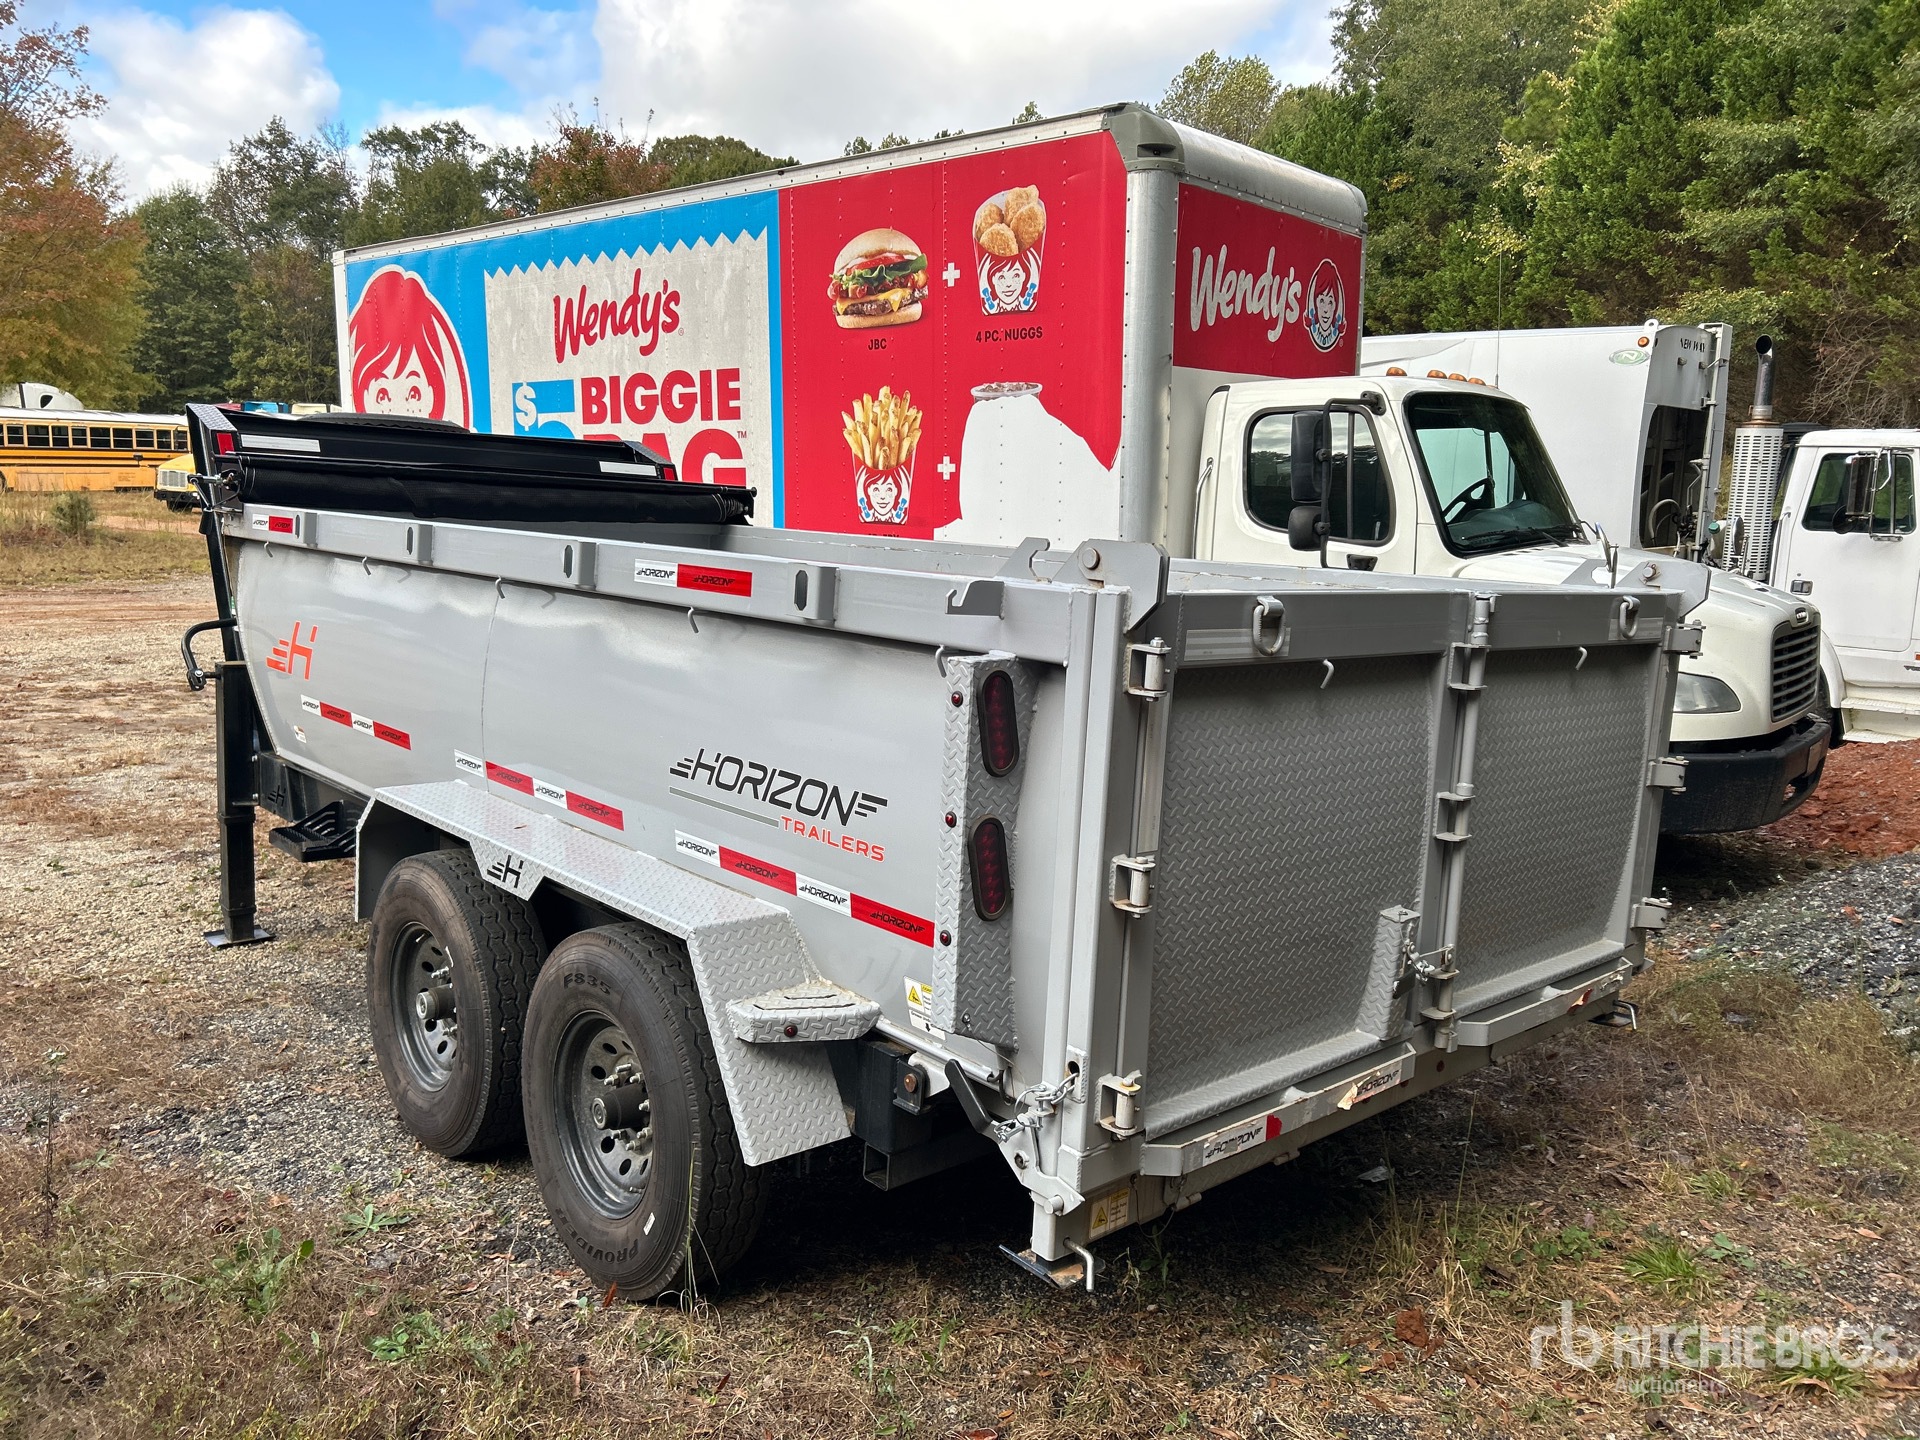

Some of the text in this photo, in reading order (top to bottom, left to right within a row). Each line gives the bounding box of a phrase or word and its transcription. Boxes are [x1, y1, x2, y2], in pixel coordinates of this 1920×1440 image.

[1191, 244, 1302, 342] Wendy's
[553, 267, 681, 364] Wendy's
[868, 338, 887, 350] JBC
[975, 326, 1043, 343] 4 PC. NUGGS
[581, 368, 742, 424] BIGGIE
[641, 567, 671, 579] HORIZON
[690, 748, 860, 828] HORIZON
[682, 839, 713, 857] HORIZON
[780, 815, 885, 863] TRAILERS
[740, 861, 775, 880] HORIZON
[804, 884, 841, 905] HORIZON
[876, 910, 918, 934] HORIZON
[563, 972, 612, 996] F835
